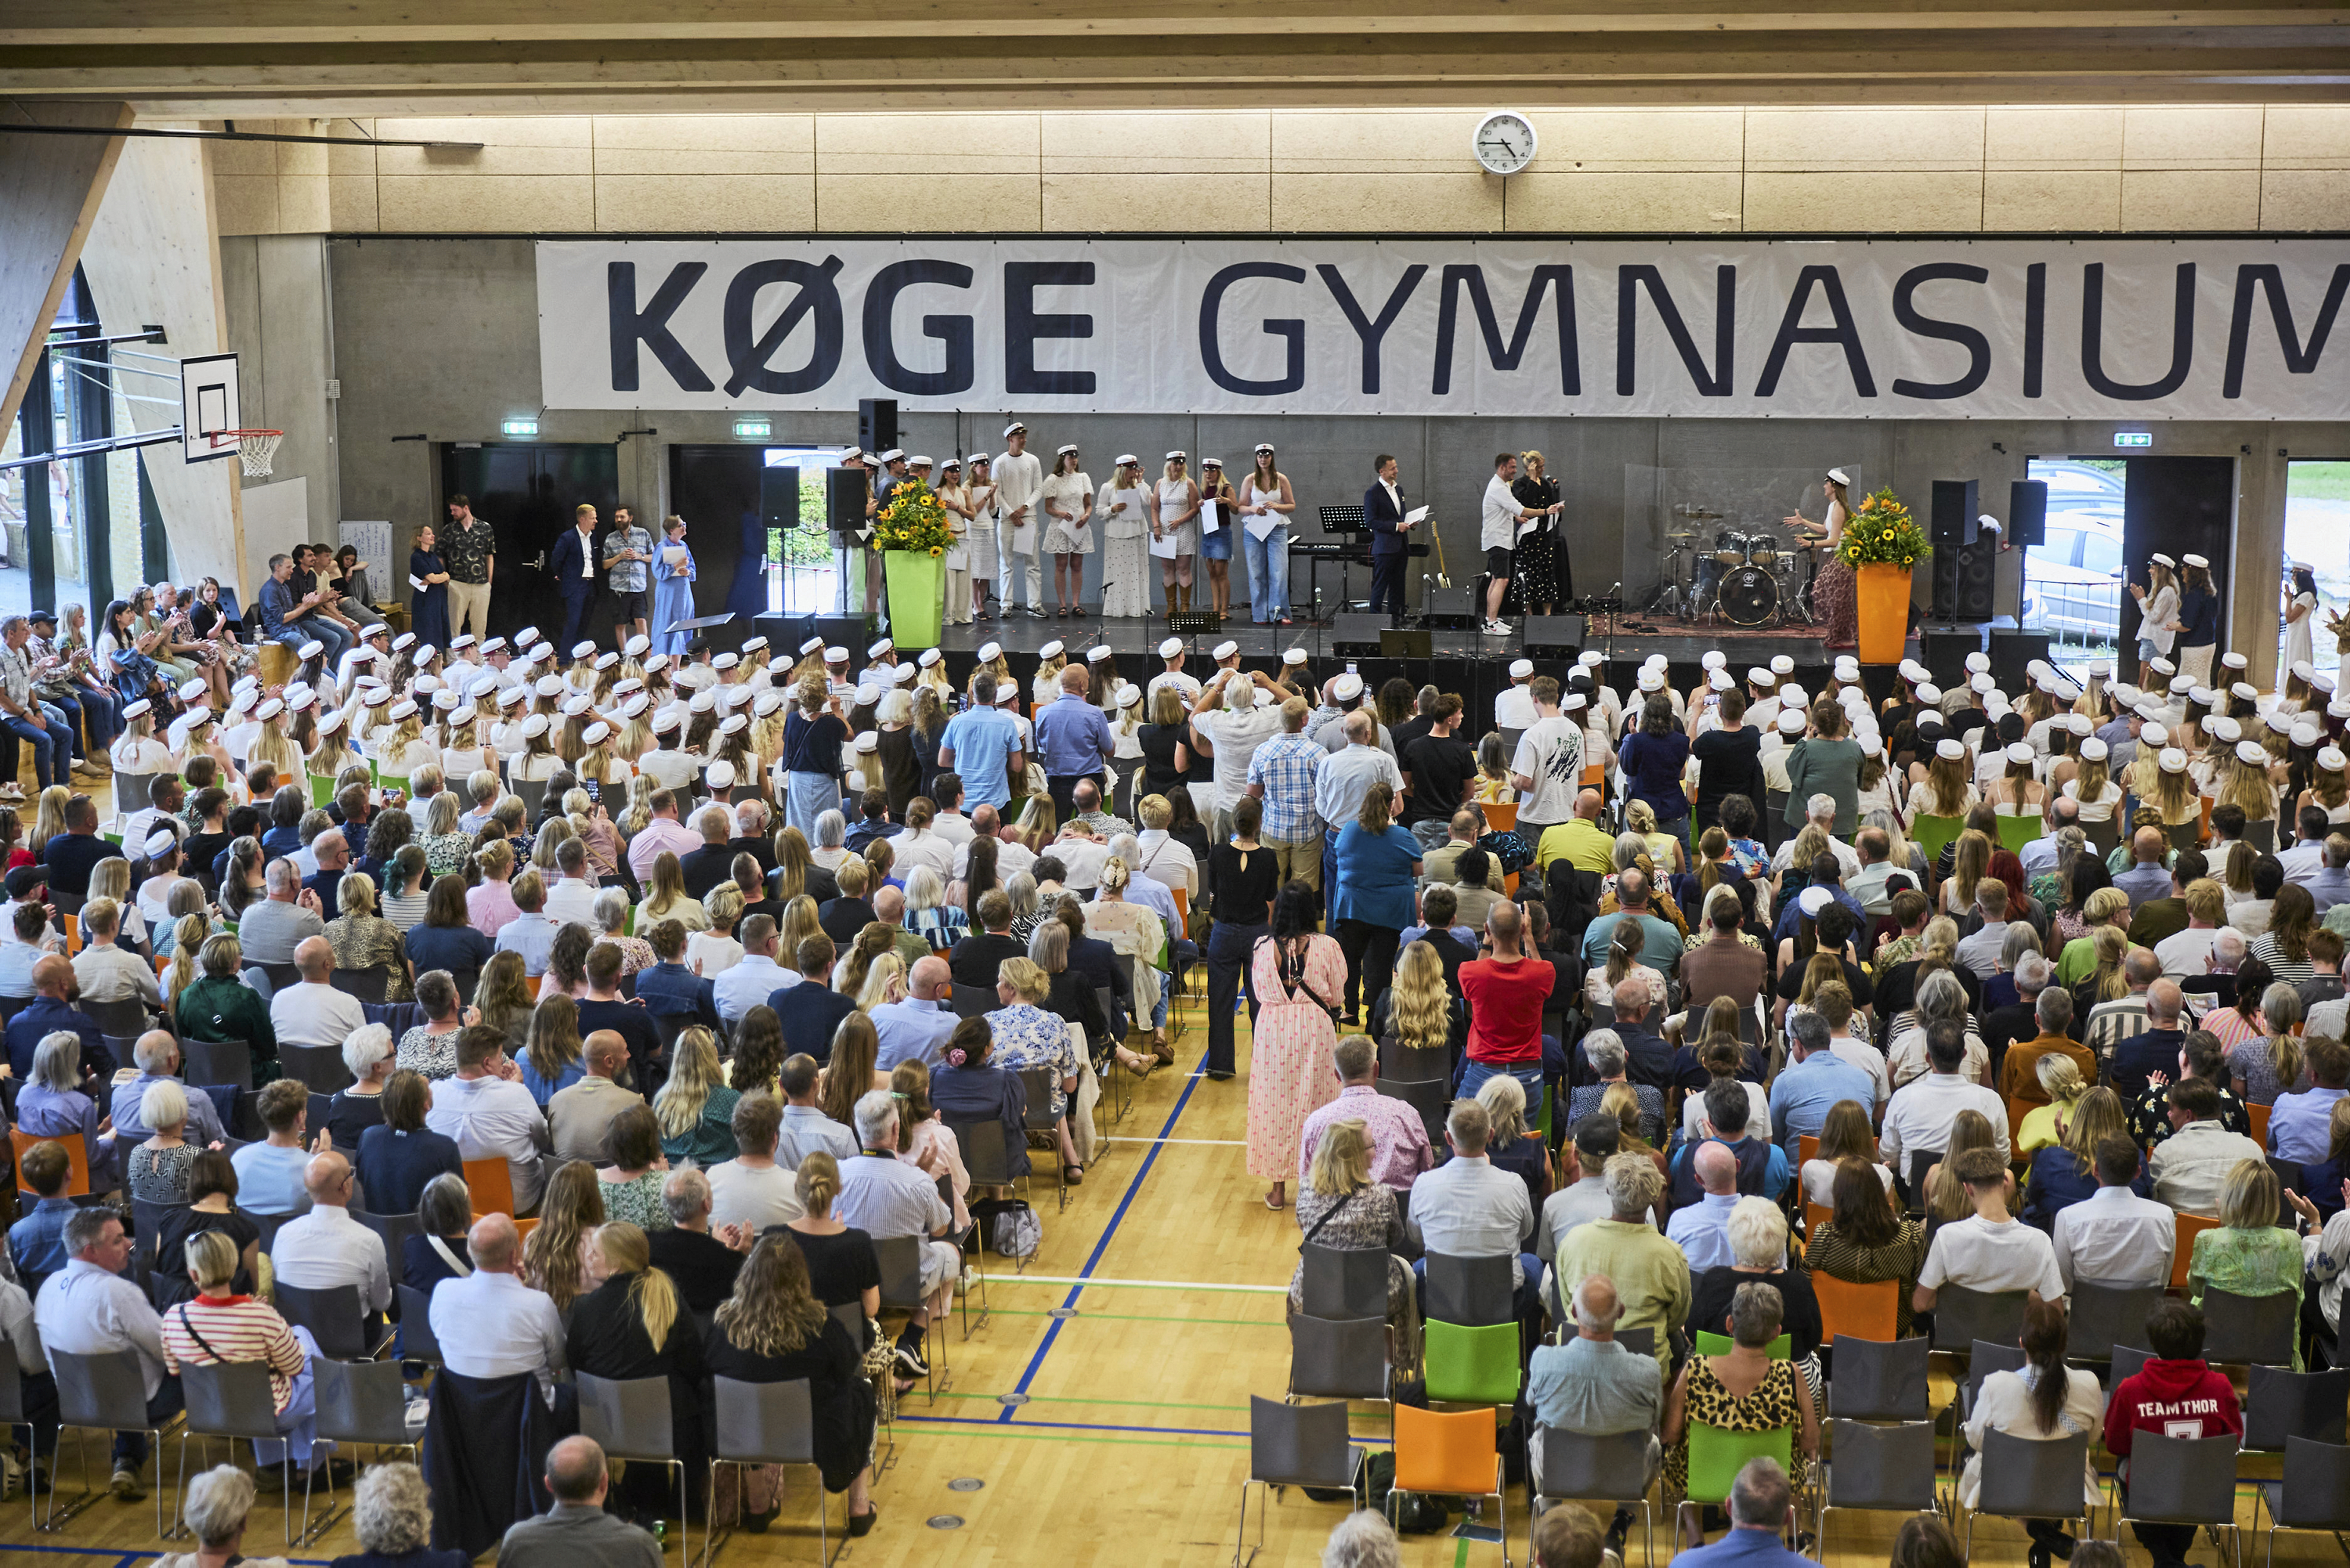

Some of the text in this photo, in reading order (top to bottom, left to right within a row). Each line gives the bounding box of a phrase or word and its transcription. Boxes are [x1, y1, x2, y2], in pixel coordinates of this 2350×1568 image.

[608, 255, 2350, 401] KØGE GYMNASIUM
[2138, 1399, 2218, 1417] TEAM THOR
